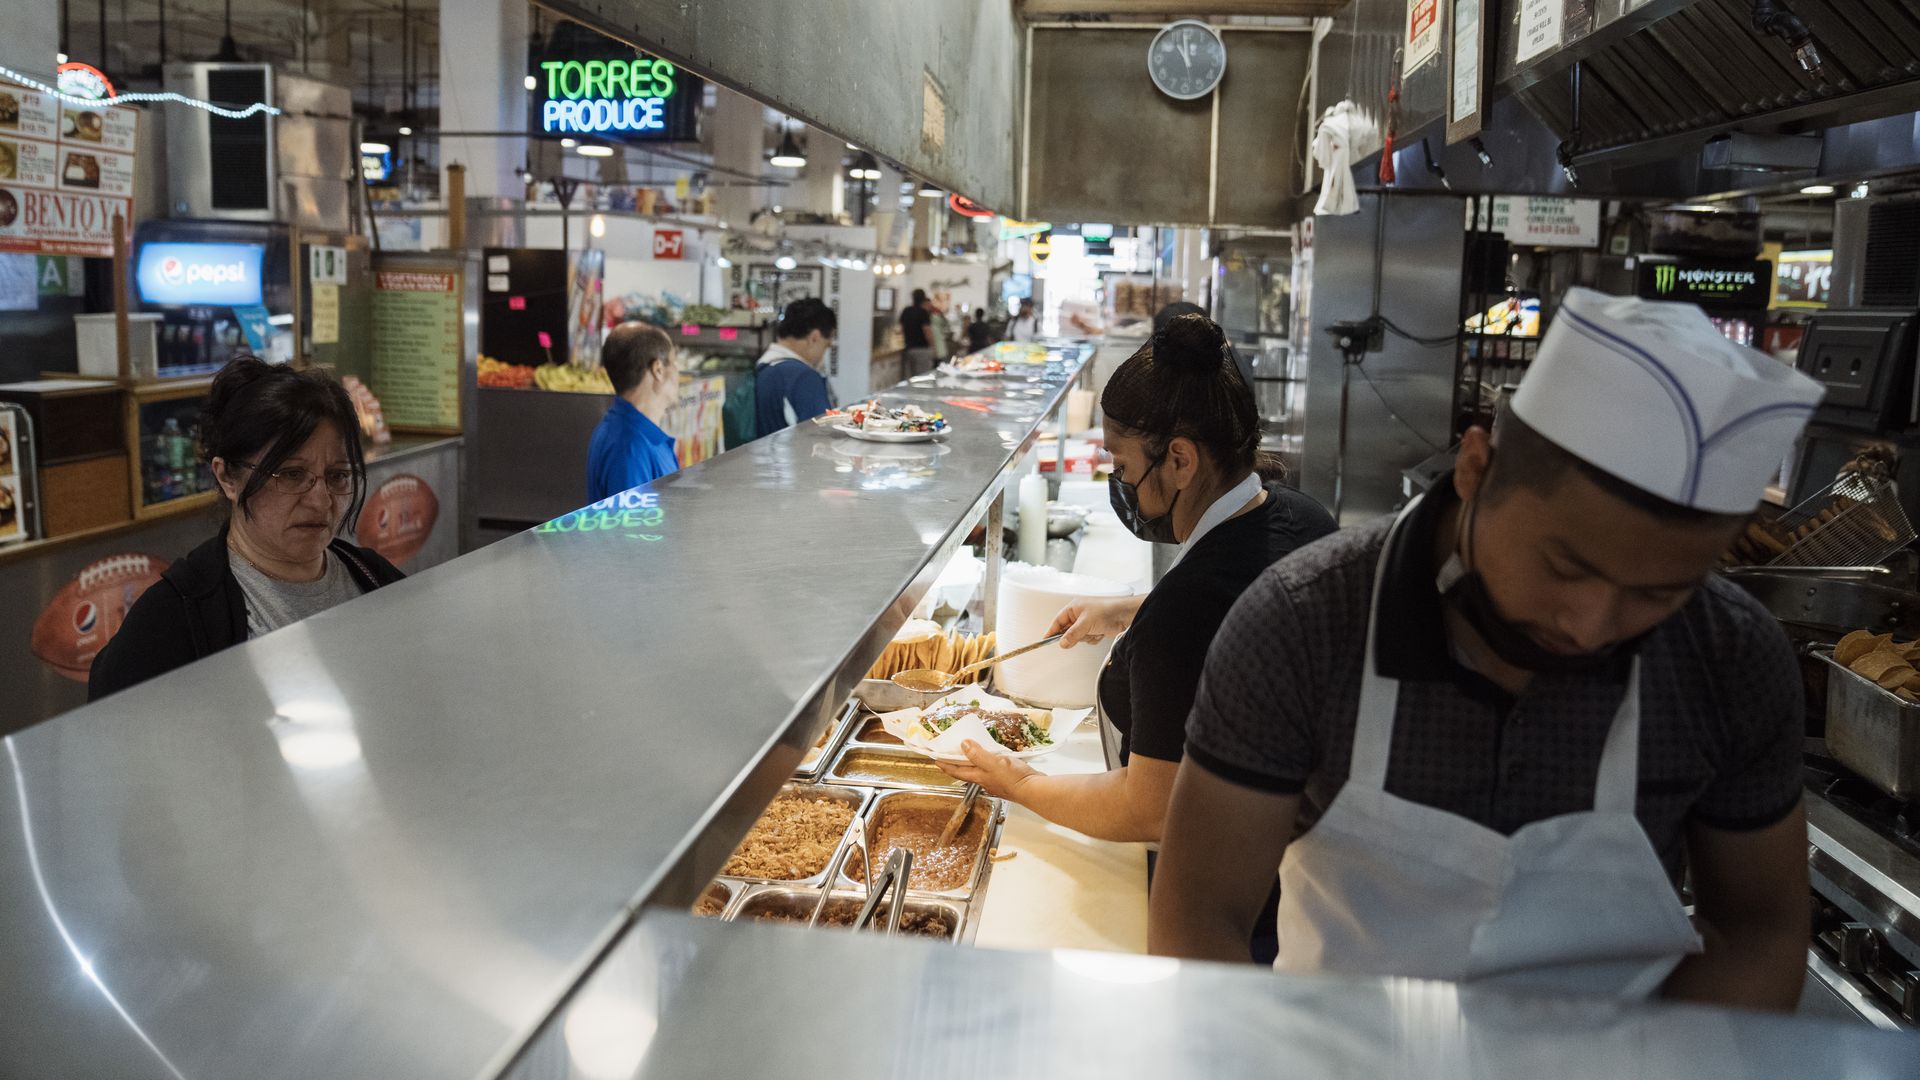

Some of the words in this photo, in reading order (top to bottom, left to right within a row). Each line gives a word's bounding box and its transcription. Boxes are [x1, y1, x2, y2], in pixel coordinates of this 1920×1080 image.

[541, 58, 674, 100] TORRES
[543, 97, 665, 132] PRODUCE
[24, 191, 95, 232] BENTO
[42, 258, 62, 287] A
[186, 261, 245, 285] pepsi
[1678, 268, 1756, 285] MONSTER
[1688, 283, 1745, 292] ENERGY
